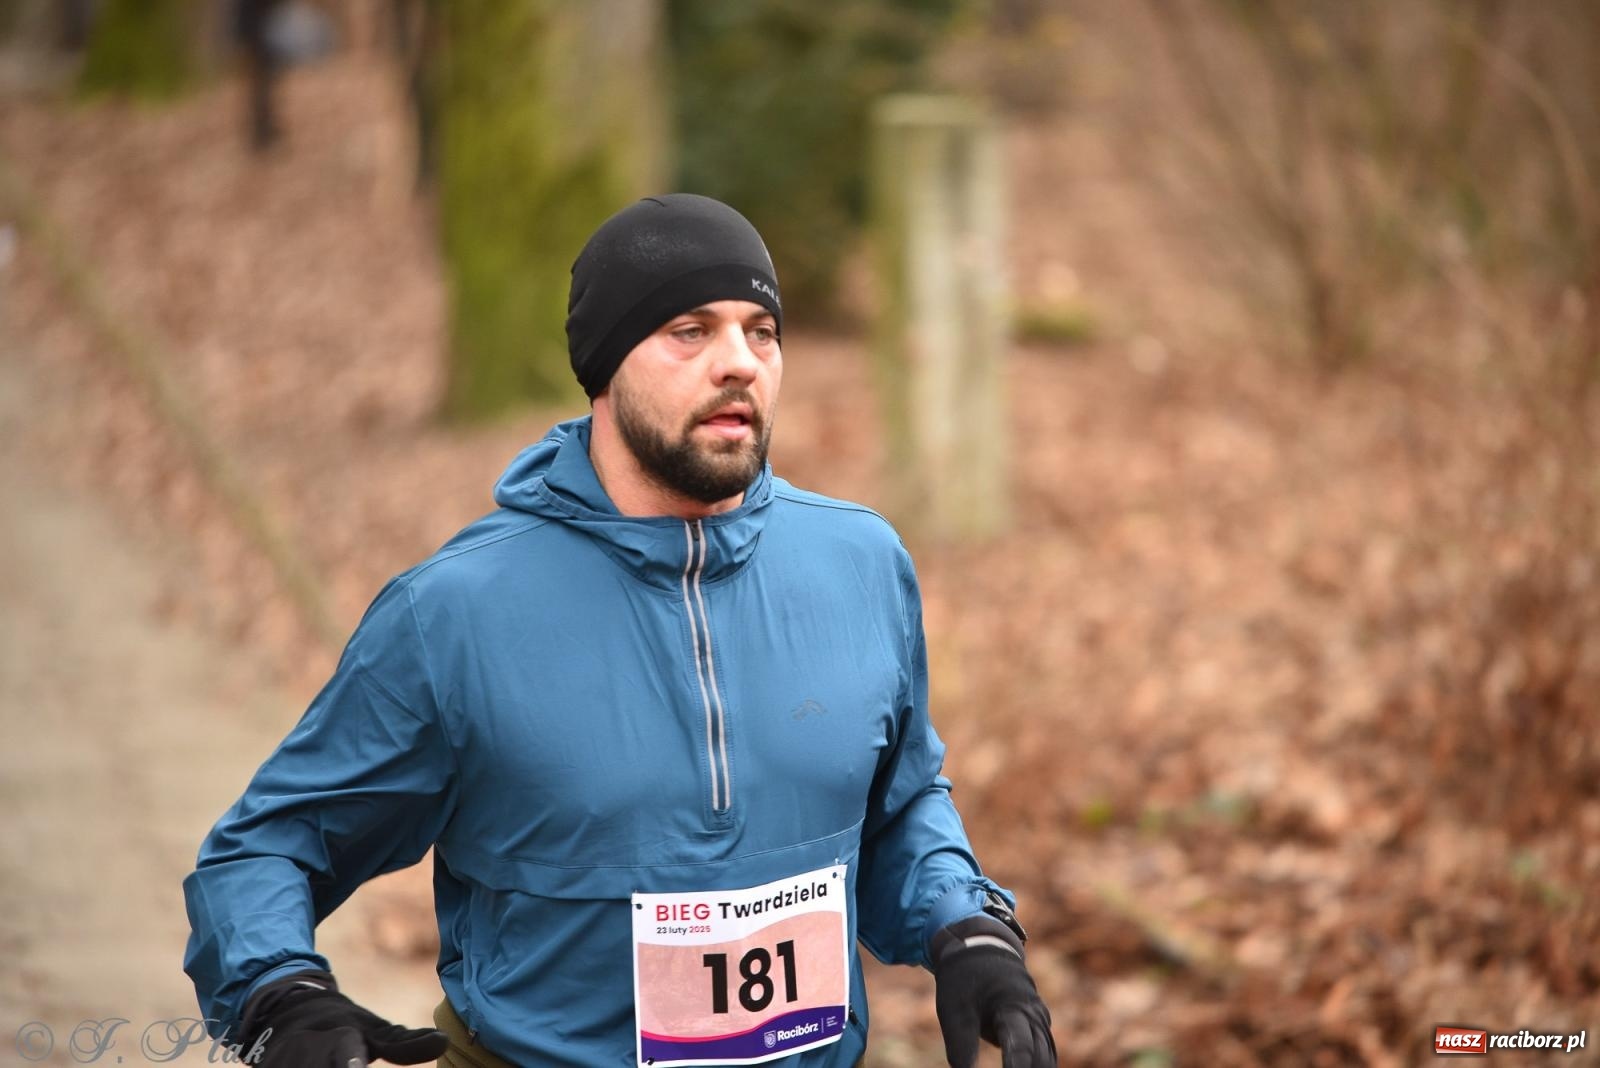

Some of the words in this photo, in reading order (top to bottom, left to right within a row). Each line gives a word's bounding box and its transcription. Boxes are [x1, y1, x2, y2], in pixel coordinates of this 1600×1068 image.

[656, 903, 711, 921] BIEG
[718, 882, 828, 919] Twardziela
[656, 926, 667, 934] 23
[669, 925, 687, 935] luty
[689, 925, 711, 933] 2025
[703, 939, 798, 1014] 181
[777, 1022, 819, 1041] Racibórz
